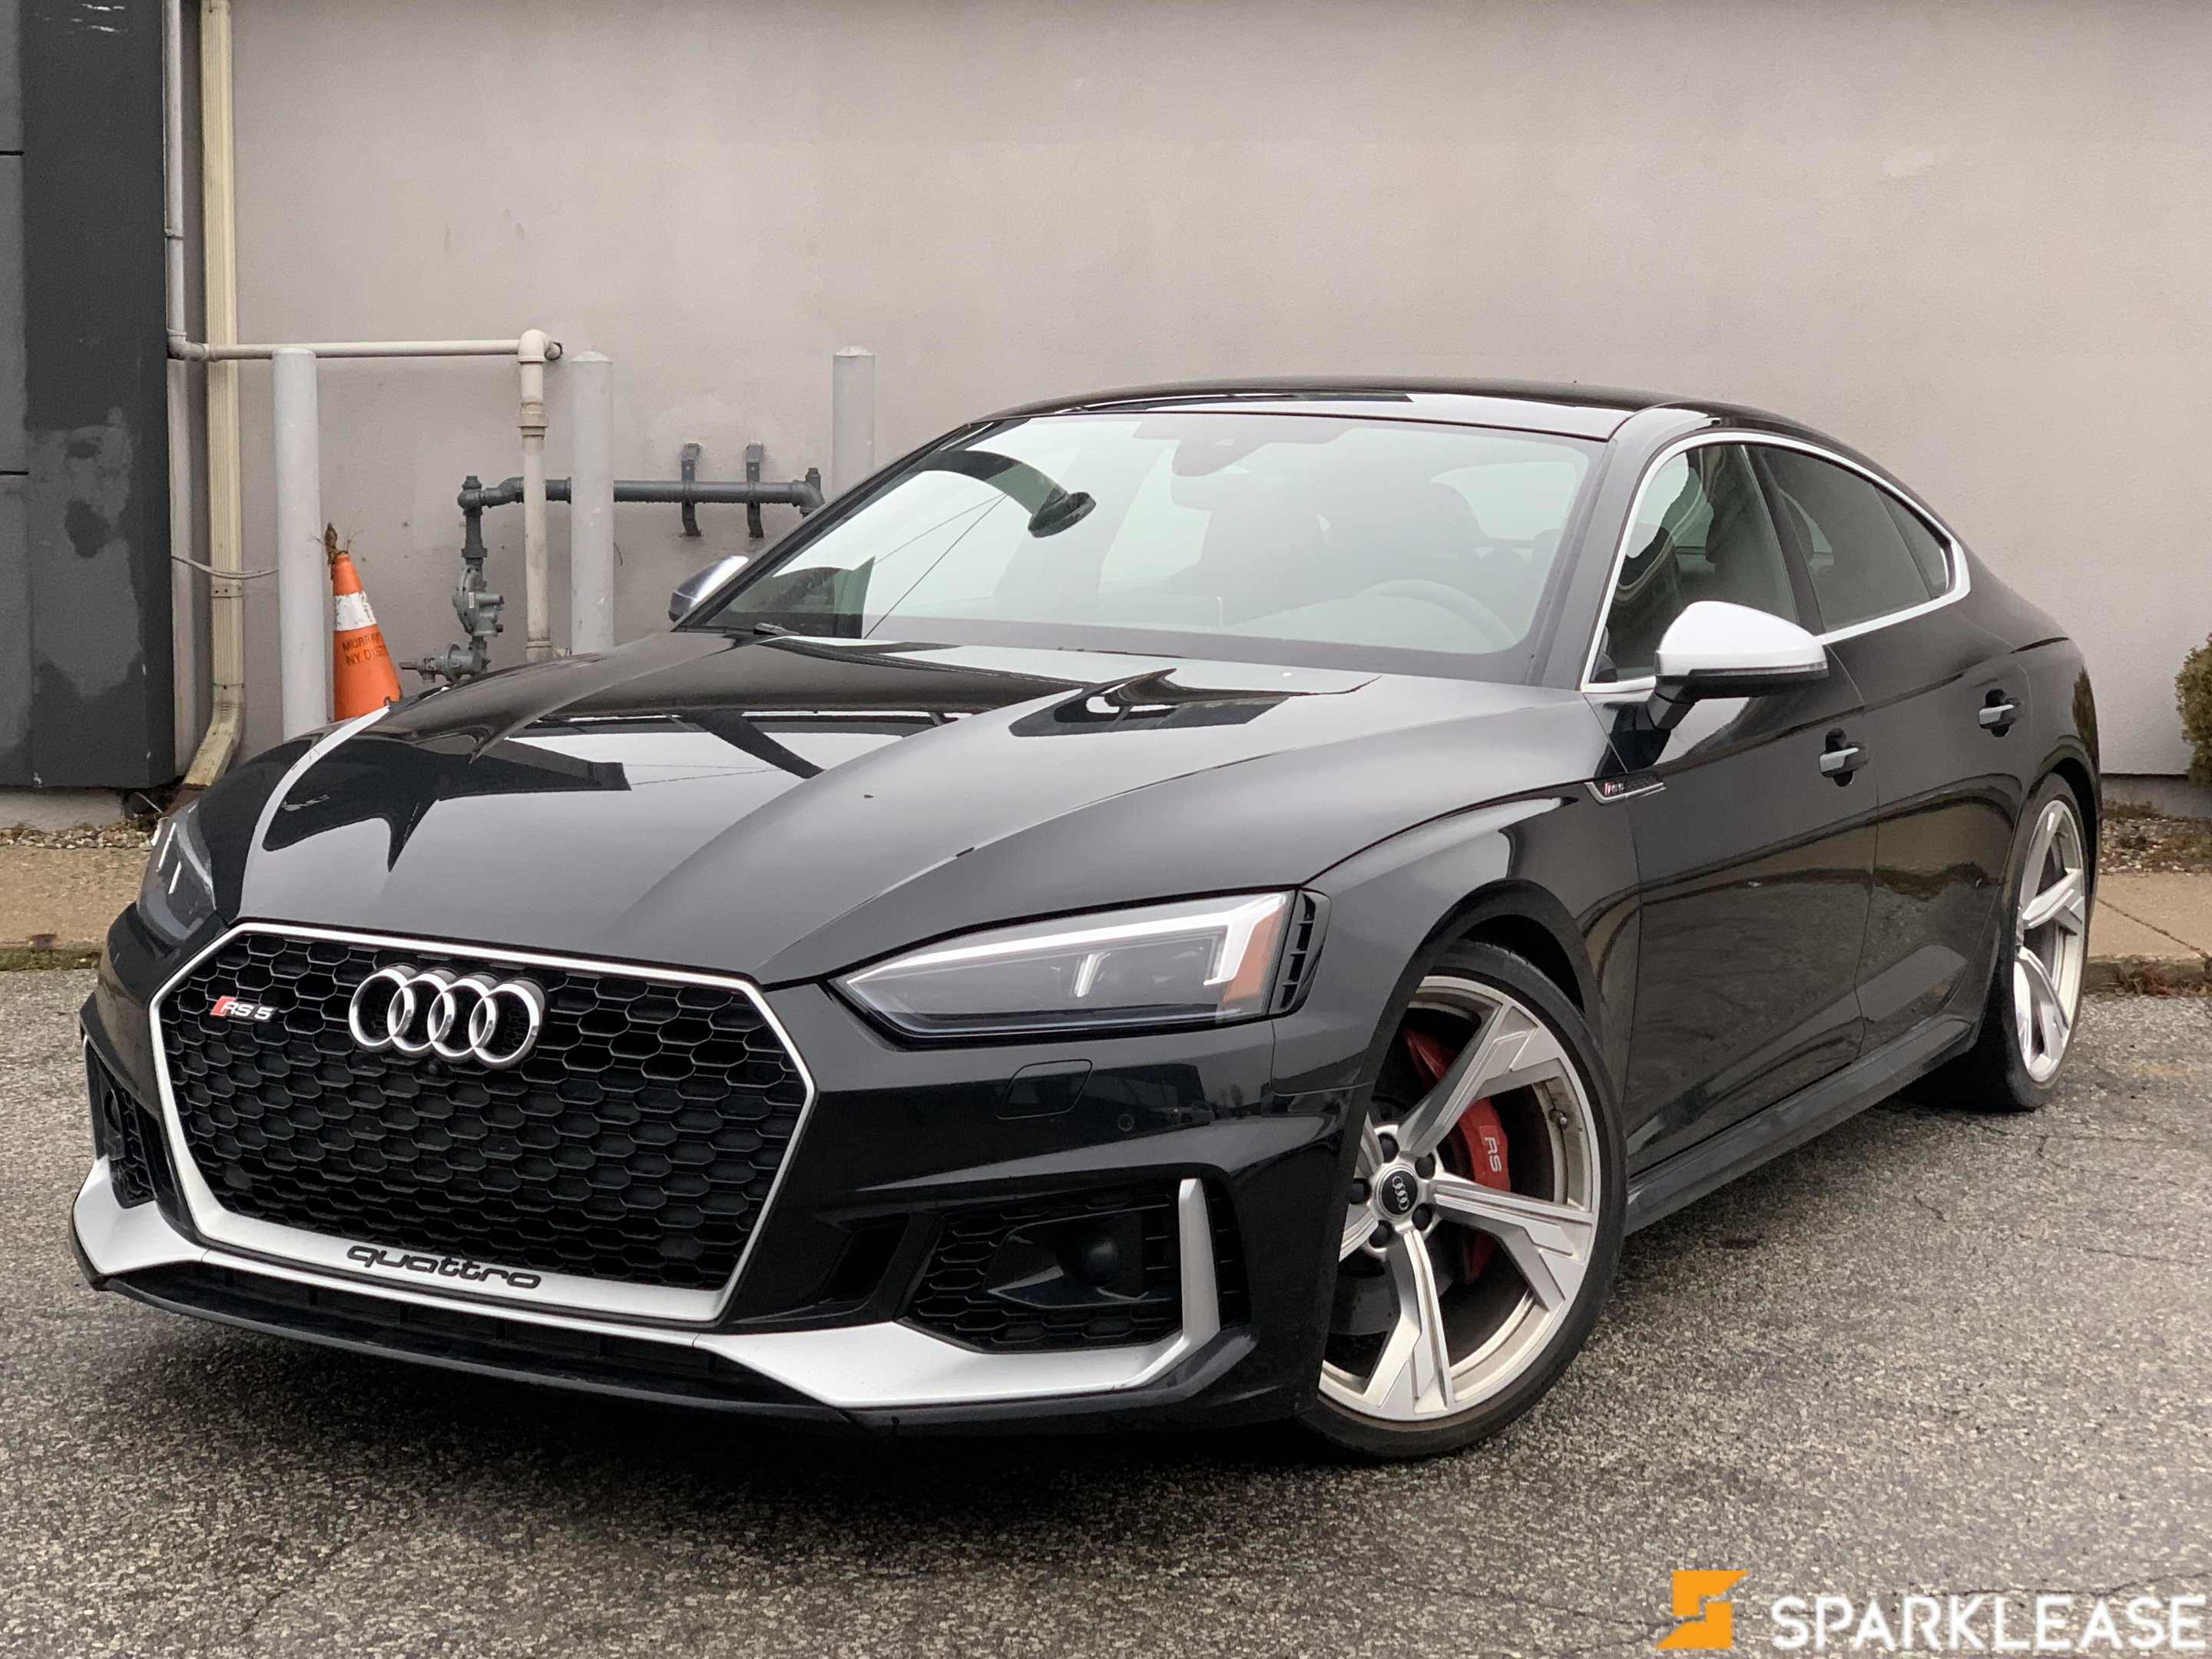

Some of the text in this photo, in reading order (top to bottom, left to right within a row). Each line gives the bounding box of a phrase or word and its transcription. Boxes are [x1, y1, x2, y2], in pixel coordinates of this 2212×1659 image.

[220, 1001, 273, 1020] RS 5
[1485, 1137, 1502, 1173] RS
[346, 1245, 541, 1289] quattro
